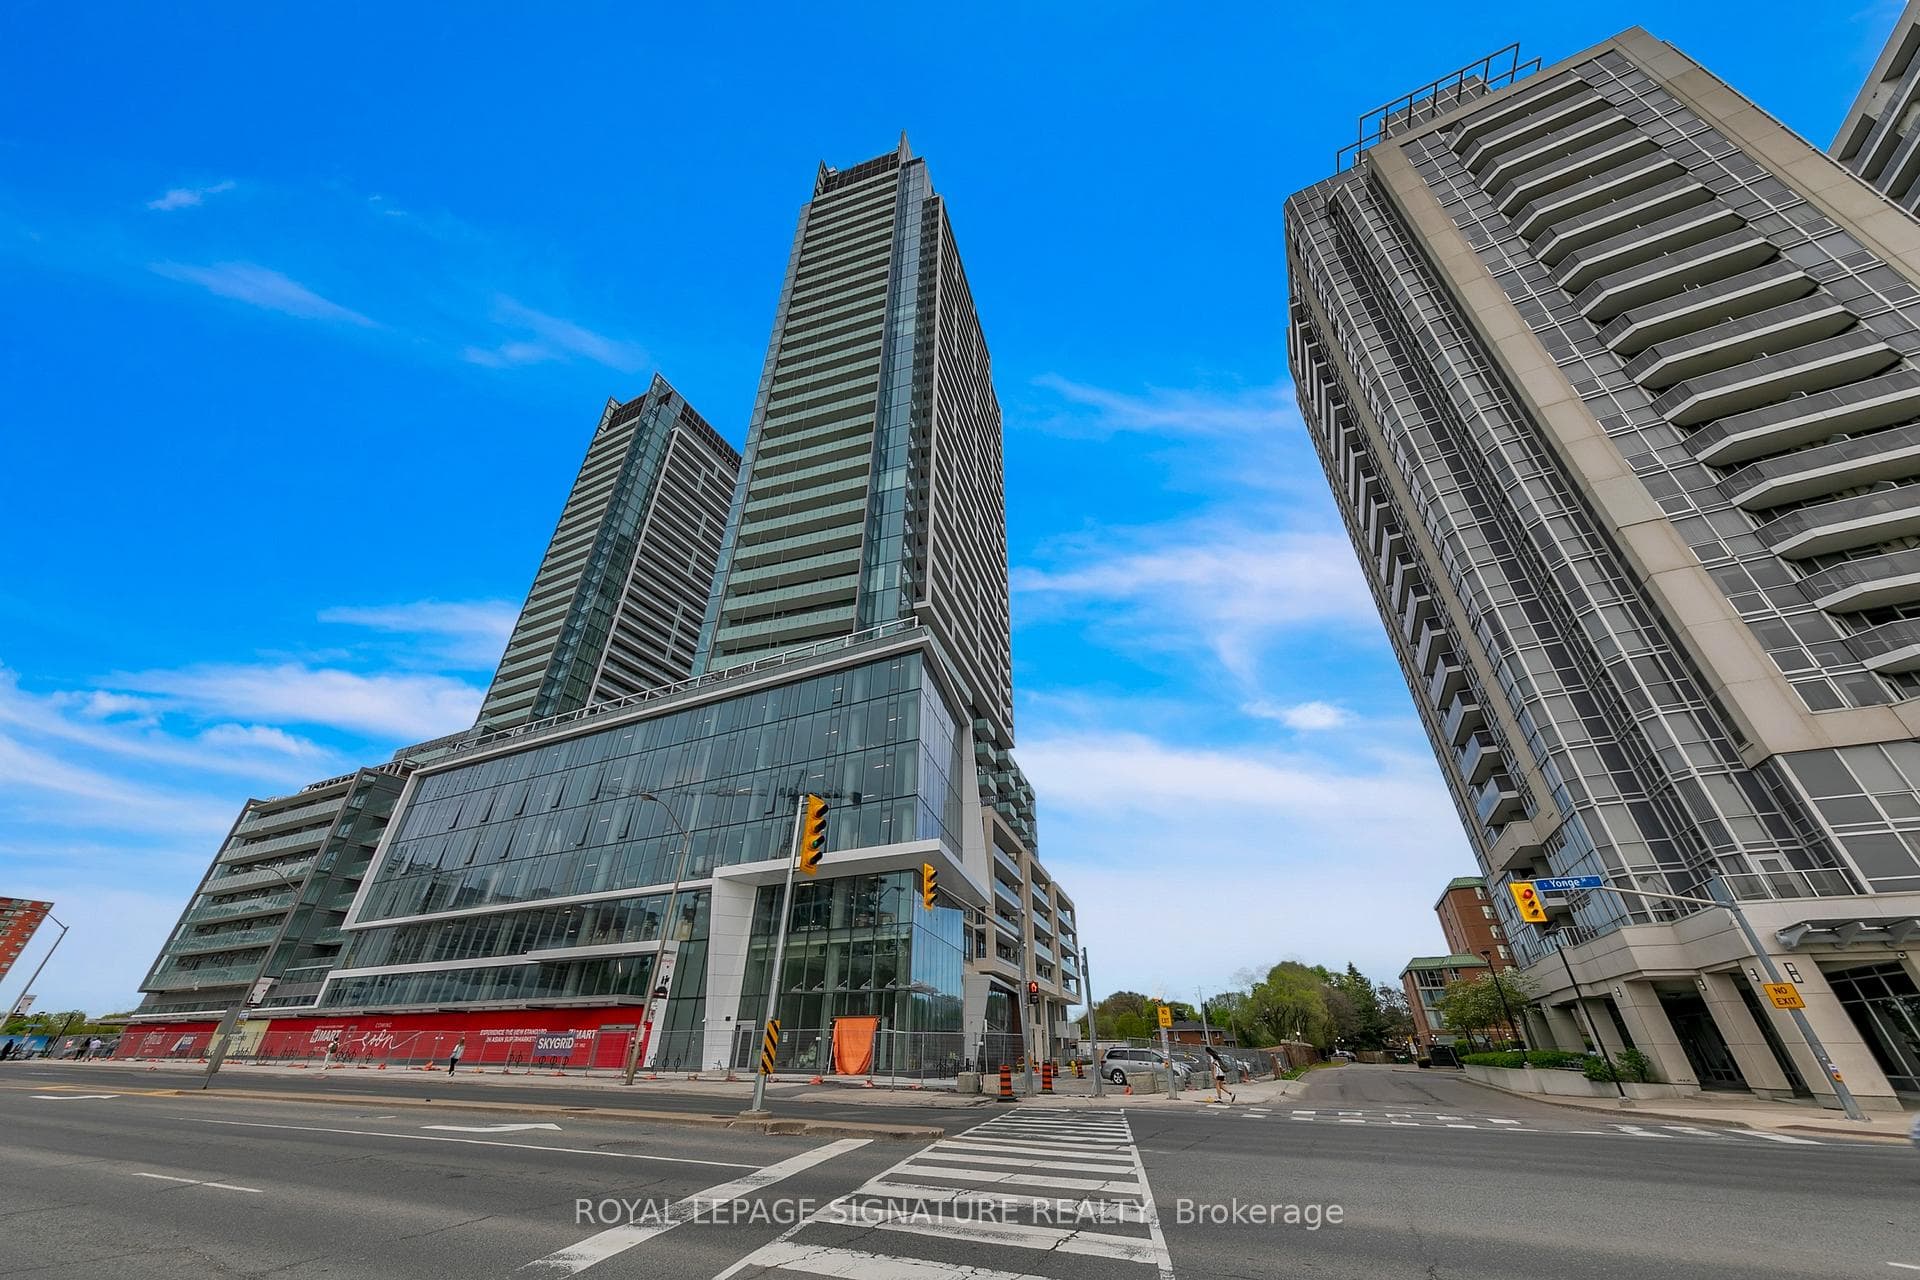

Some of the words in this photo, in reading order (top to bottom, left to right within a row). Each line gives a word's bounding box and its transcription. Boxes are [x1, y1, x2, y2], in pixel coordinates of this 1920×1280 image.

[1549, 879, 1580, 888] Yonge
[1776, 997, 1797, 1005] EXIT
[576, 1029, 598, 1039] MART
